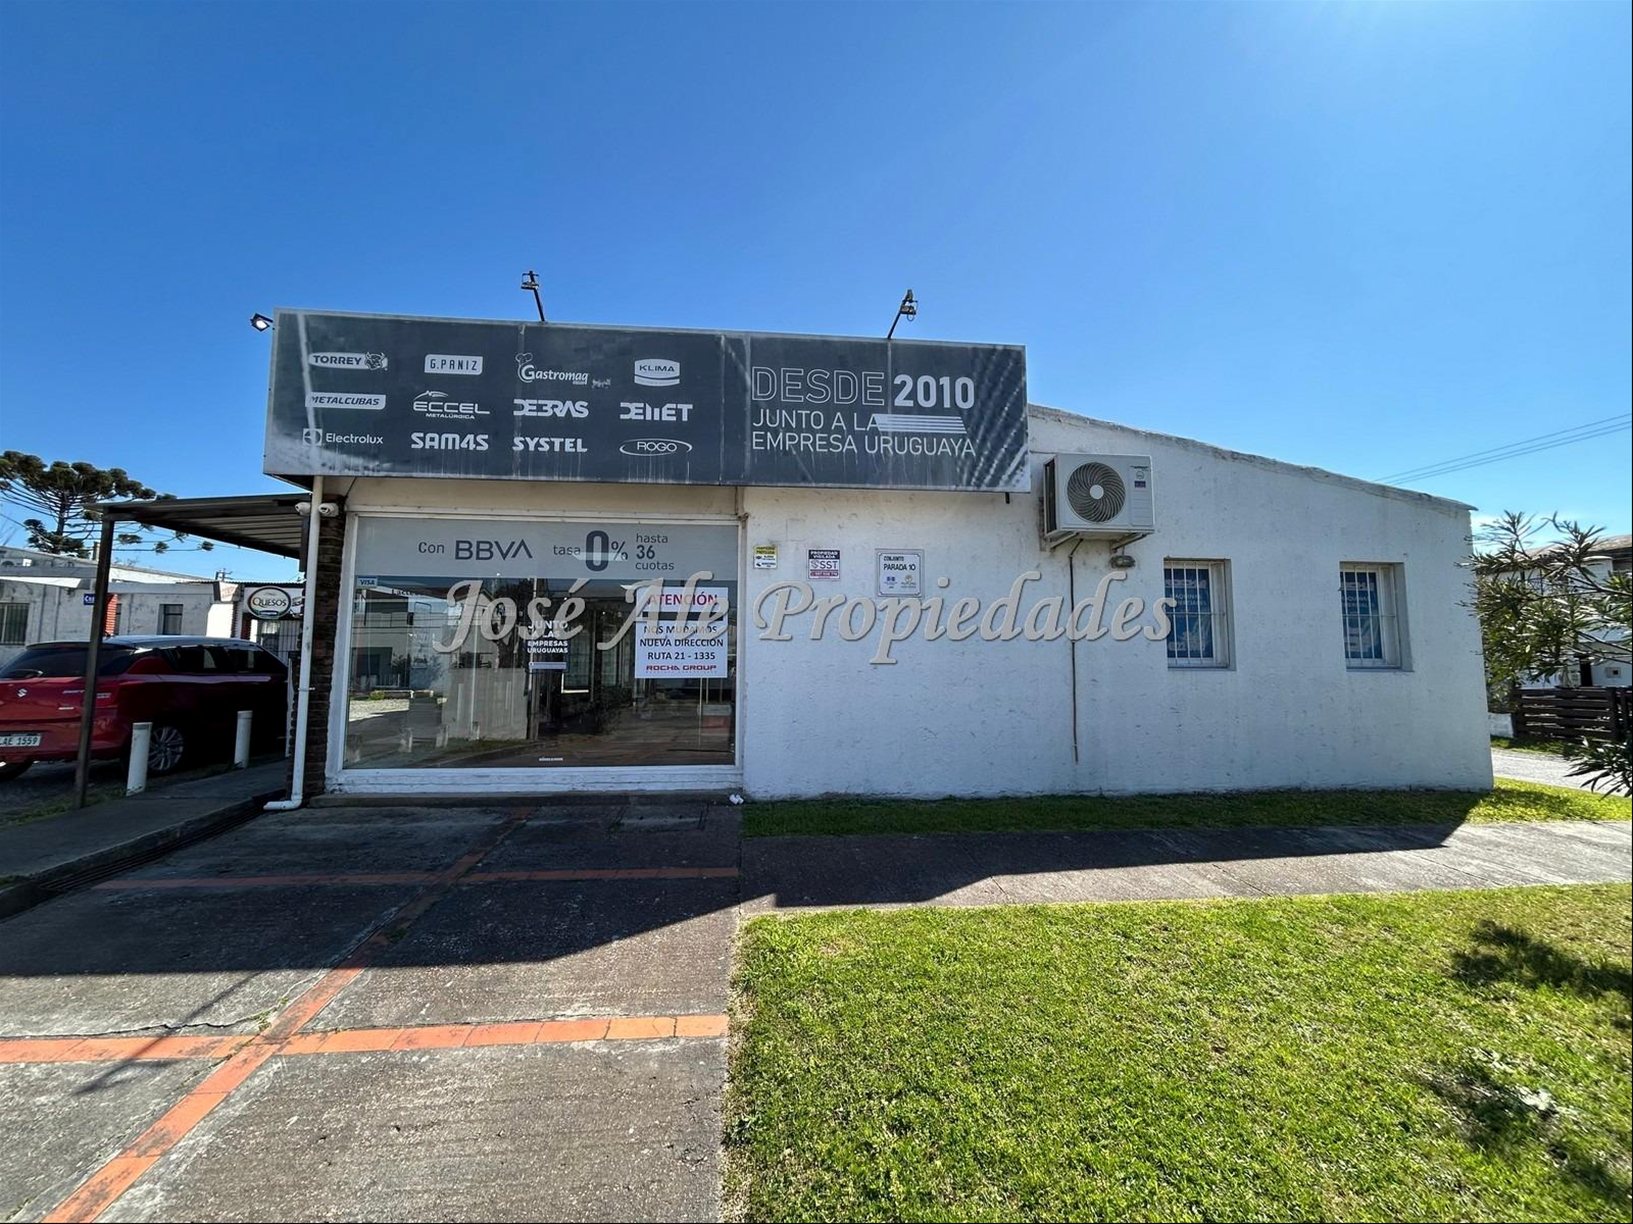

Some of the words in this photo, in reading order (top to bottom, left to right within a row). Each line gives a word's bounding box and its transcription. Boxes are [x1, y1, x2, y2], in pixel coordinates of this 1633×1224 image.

[313, 355, 362, 366] TORREY
[430, 359, 478, 371] G.PANIZ
[751, 366, 885, 406] DESDE
[893, 374, 975, 409] 2010
[413, 401, 491, 415] ECCEL
[752, 408, 825, 430] JUNTO
[831, 412, 847, 430] A
[853, 412, 880, 432] LA
[326, 432, 384, 444] Electrolux
[411, 432, 489, 451] SAM4S
[752, 431, 858, 454] EMPRESA
[864, 436, 976, 457] URUGUAYA
[512, 437, 588, 453] SYSTEL
[637, 441, 678, 453] ROGO
[635, 533, 669, 544] hasta
[418, 541, 445, 554] Con
[454, 539, 533, 561] BBVA
[553, 544, 581, 556] tasa
[636, 545, 656, 560] 36
[635, 561, 675, 571] cuotas
[883, 563, 907, 571] PARADA
[908, 563, 917, 571] 10
[646, 592, 718, 606] ATENCIÓN
[640, 639, 672, 647] NUEVA
[648, 652, 672, 660] RUTA
[674, 652, 685, 660] 21
[695, 652, 716, 660] 1335
[17, 737, 38, 745] 1559
